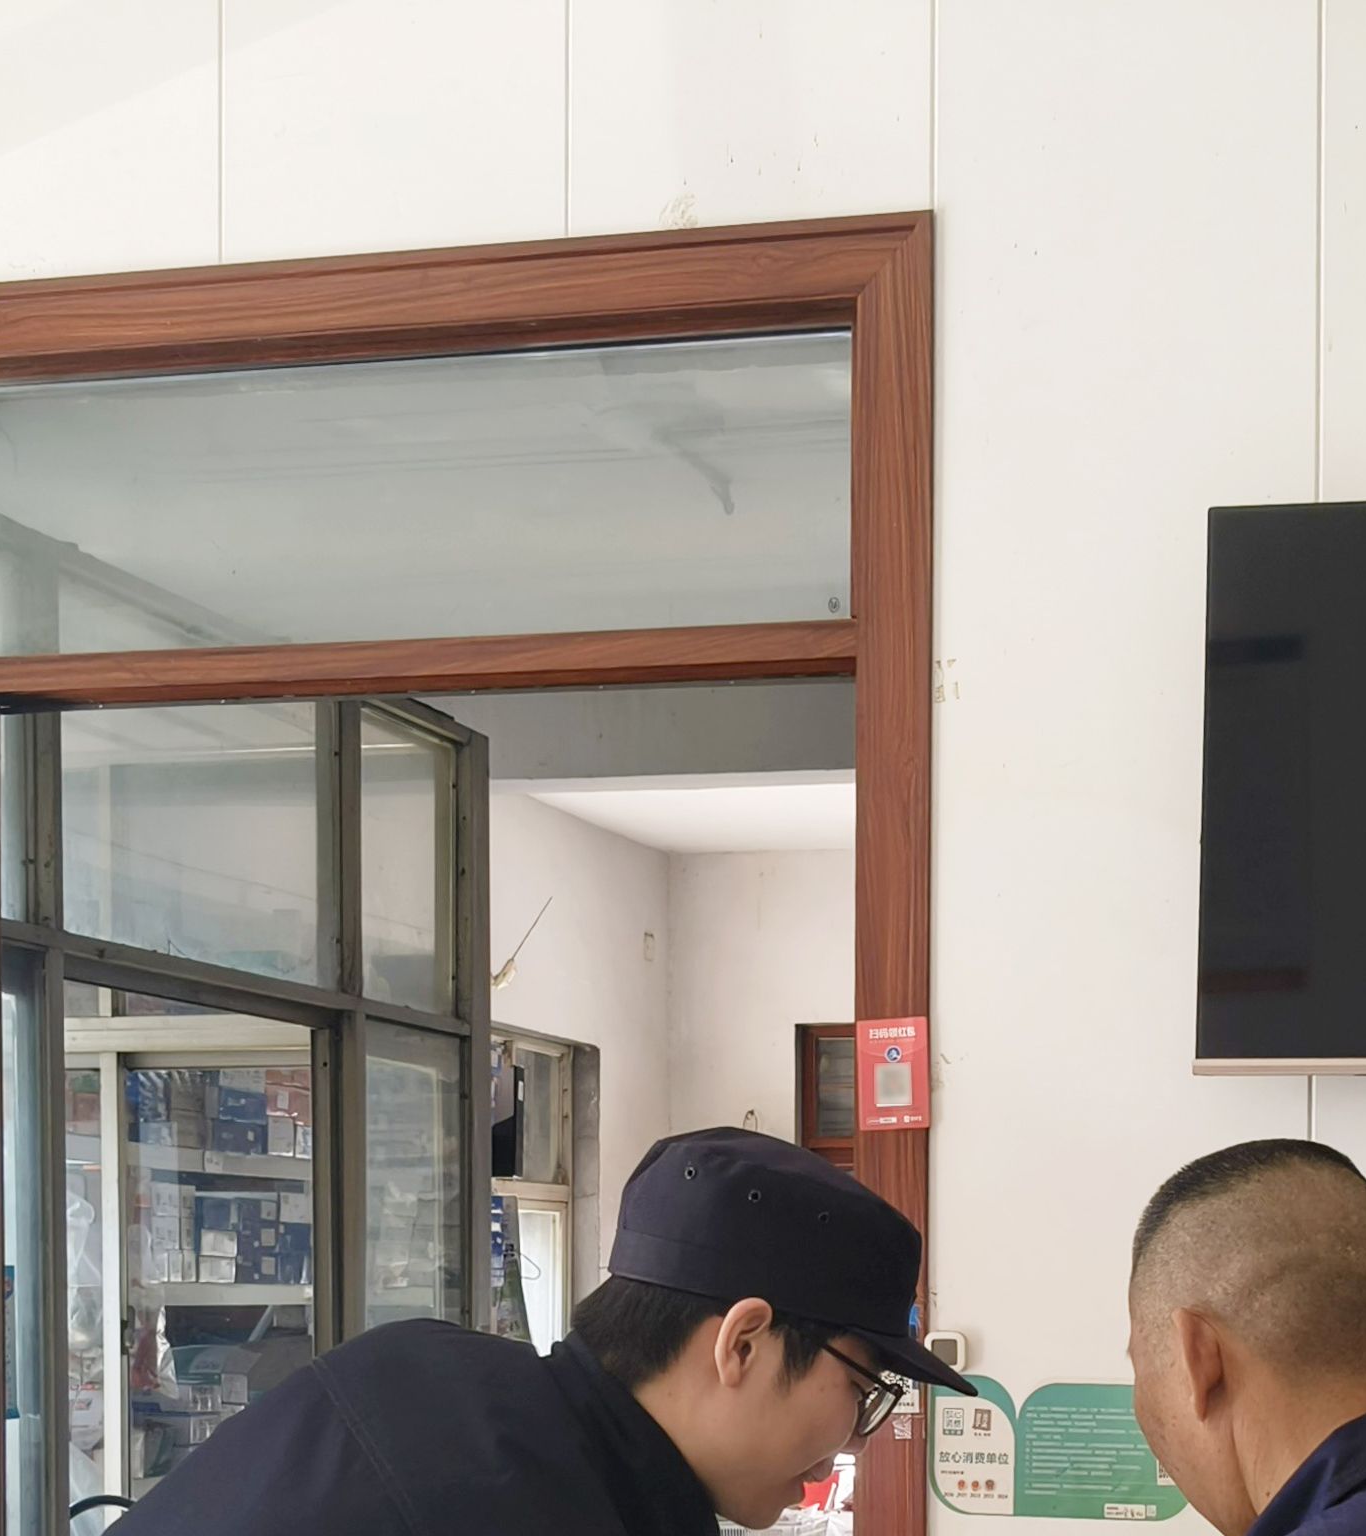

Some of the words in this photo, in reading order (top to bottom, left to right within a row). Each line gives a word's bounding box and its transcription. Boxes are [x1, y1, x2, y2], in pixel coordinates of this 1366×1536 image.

[869, 1026, 915, 1039] 扫码领红包
[939, 1451, 1009, 1465] 放心消费单位
